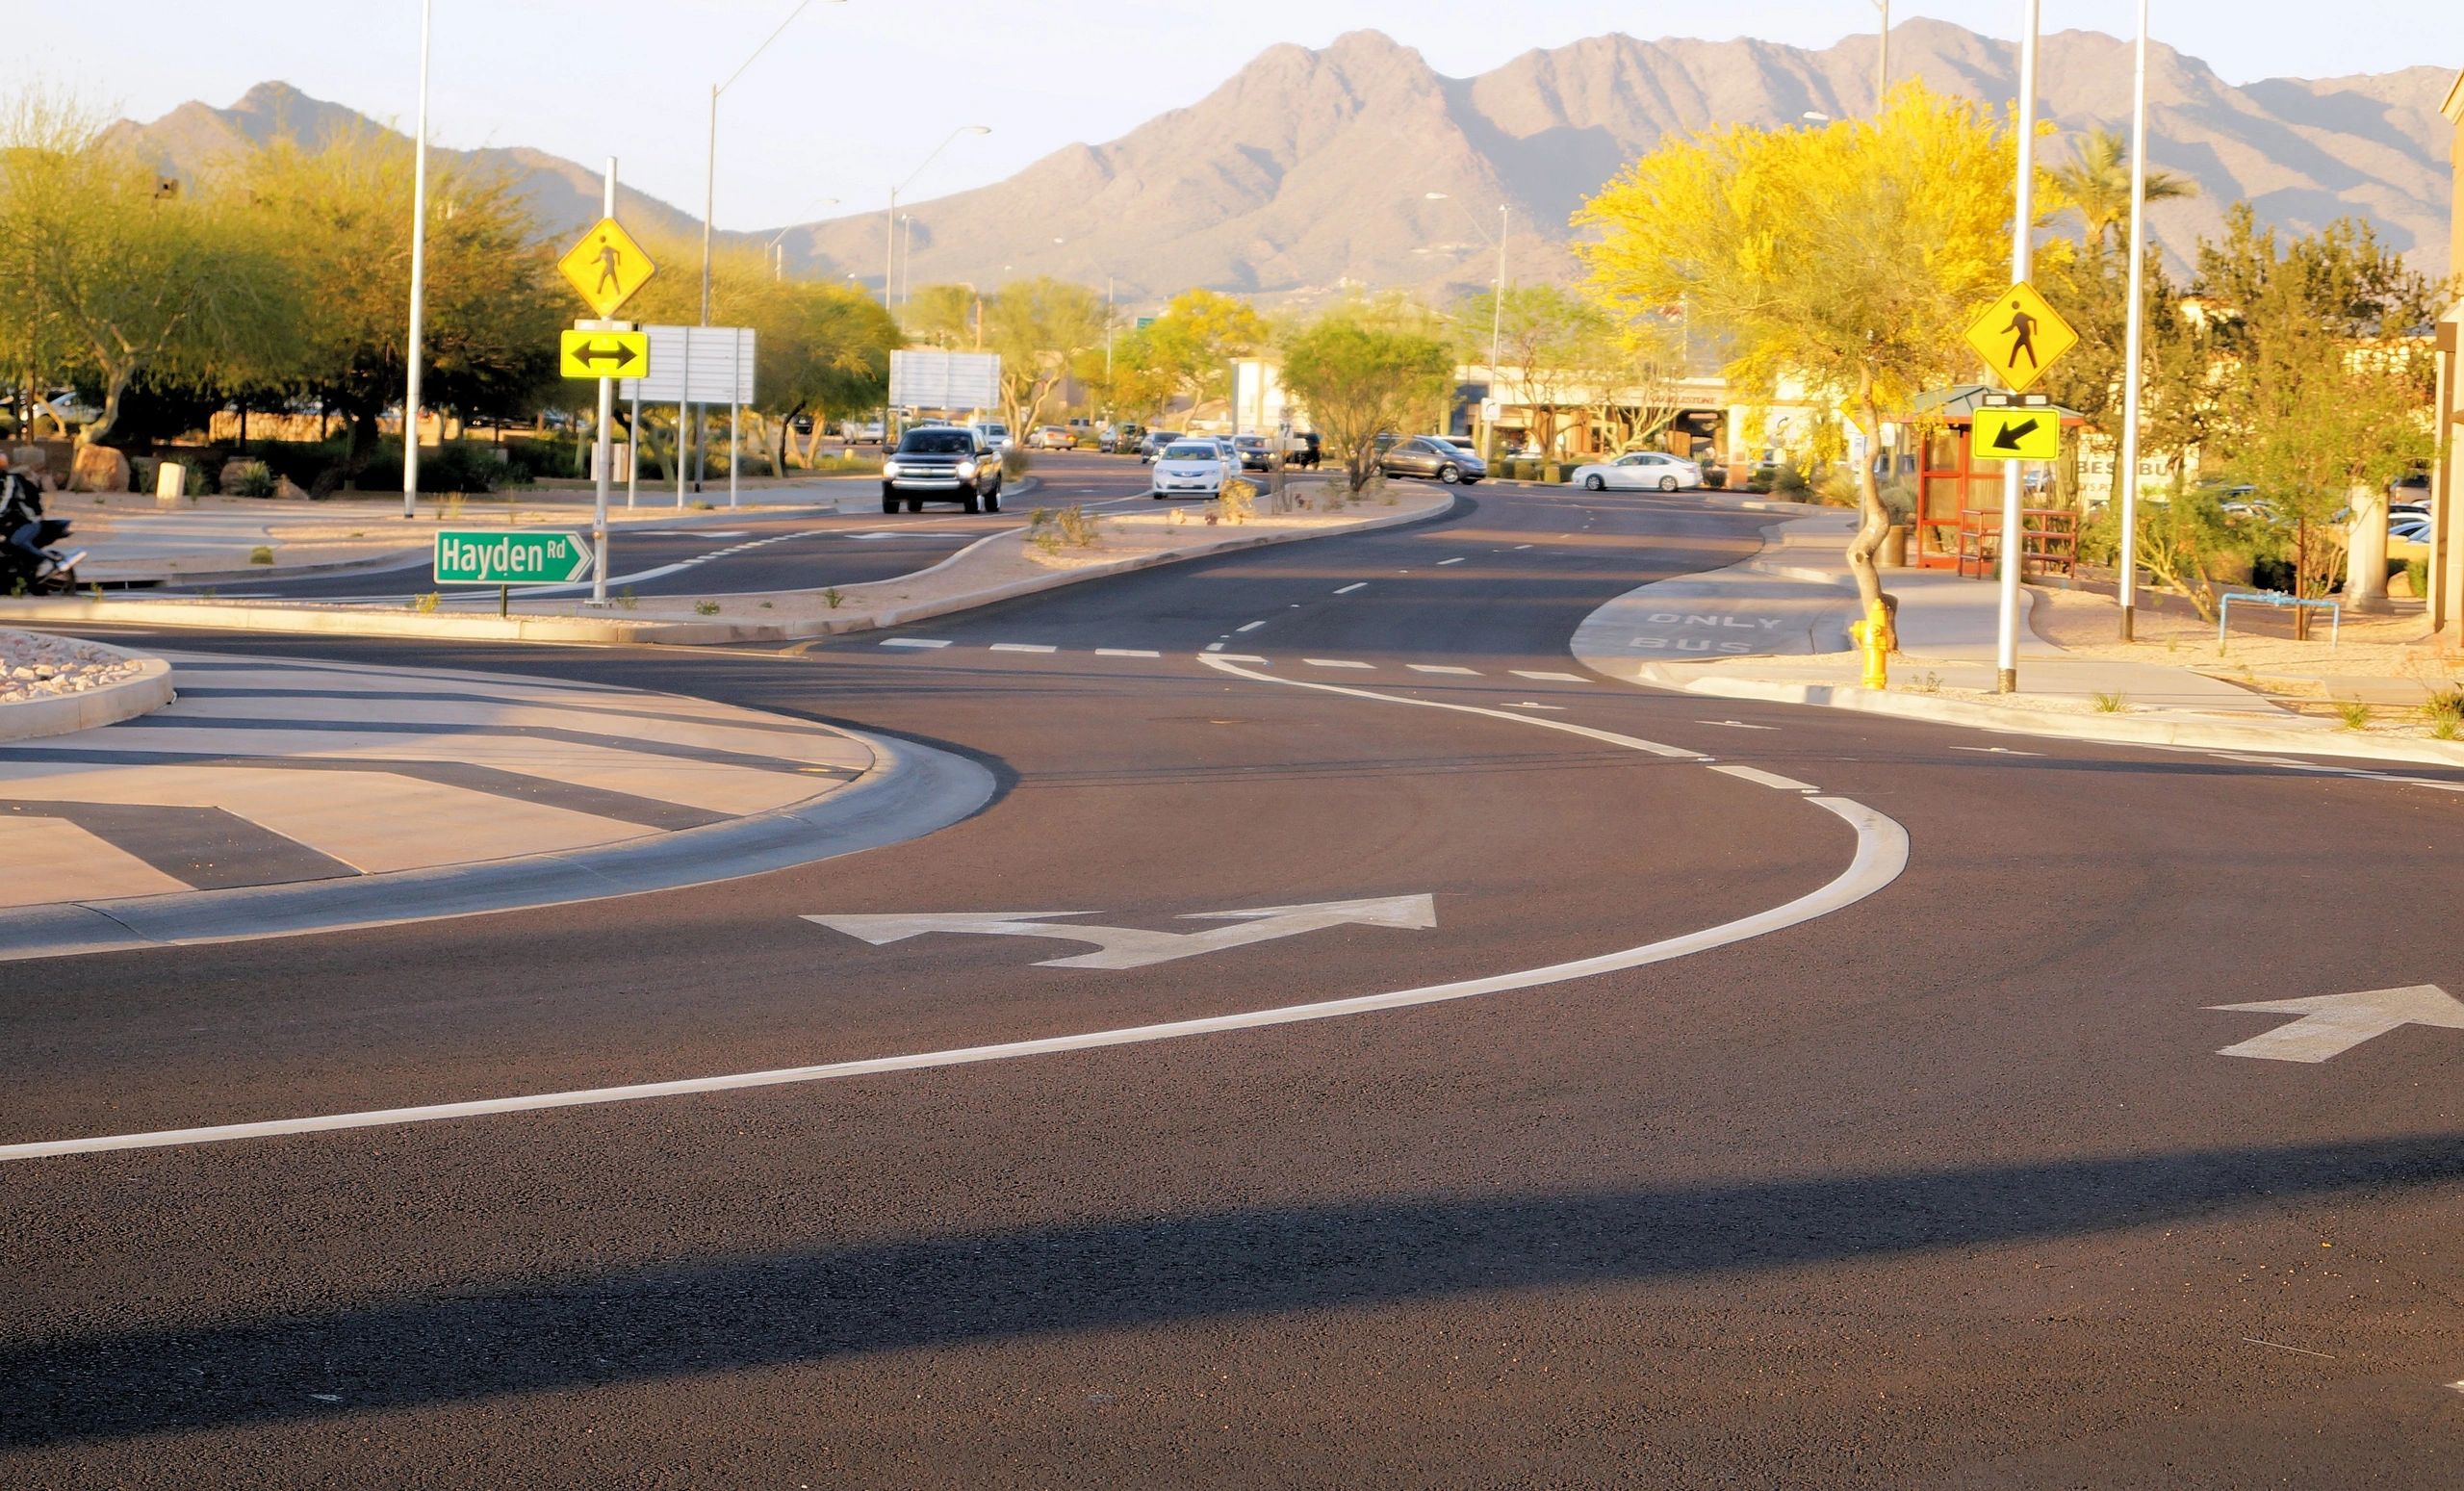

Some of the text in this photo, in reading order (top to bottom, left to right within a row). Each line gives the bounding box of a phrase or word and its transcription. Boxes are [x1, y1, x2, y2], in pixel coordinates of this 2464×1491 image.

[2077, 461, 2169, 476] BES BU
[442, 536, 566, 580] Hayden Rd
[1648, 614, 1782, 629] ONLY
[1629, 637, 1751, 653] BUS
